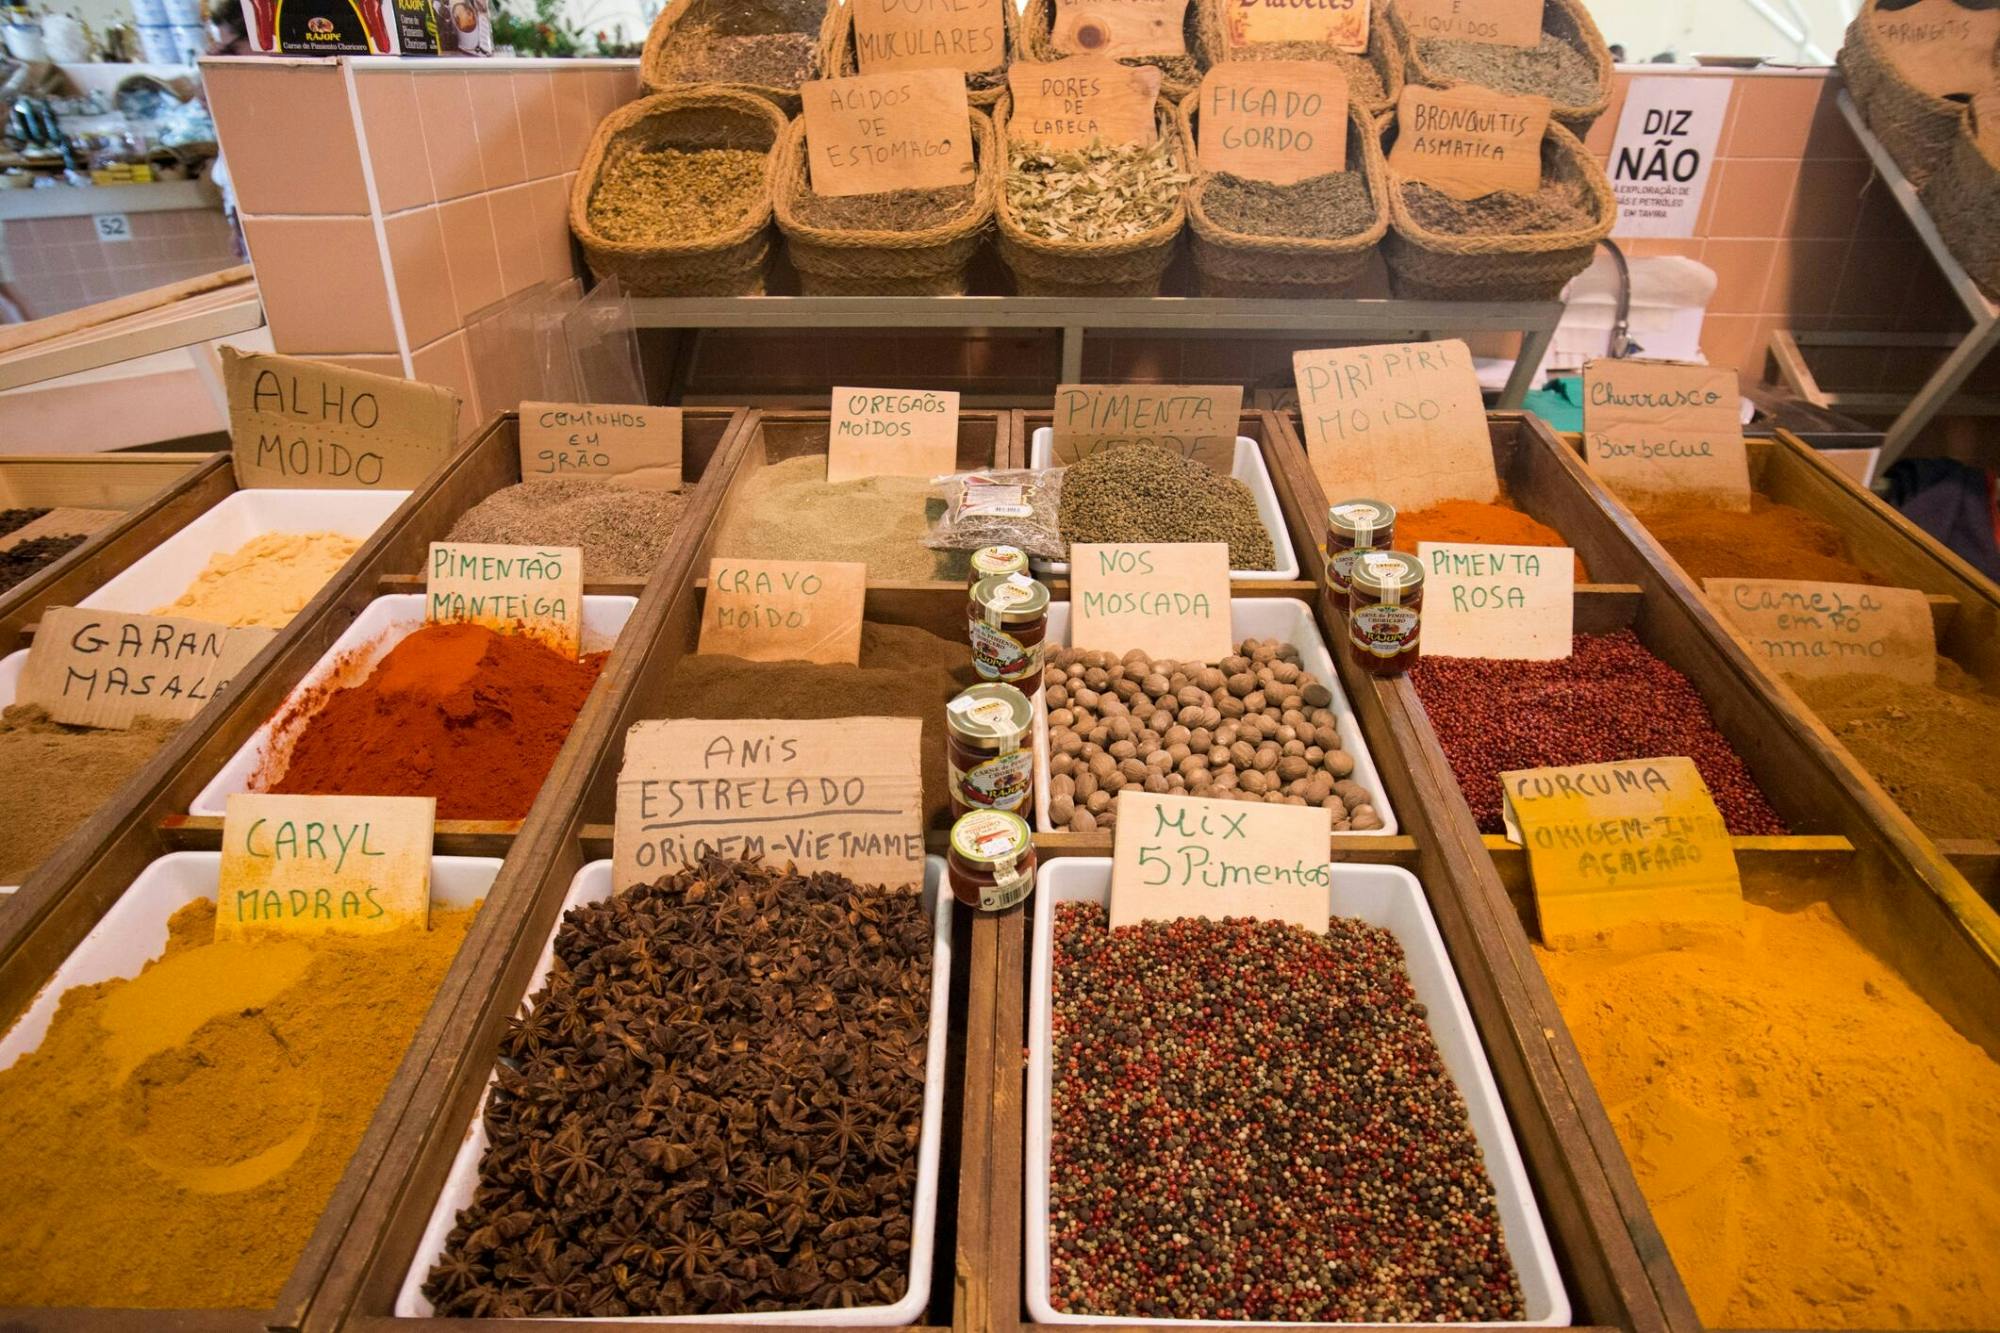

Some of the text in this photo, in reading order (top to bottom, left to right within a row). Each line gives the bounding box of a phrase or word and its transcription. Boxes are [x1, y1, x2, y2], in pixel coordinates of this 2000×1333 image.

[1043, 78, 1100, 97] DORES
[1065, 99, 1083, 114] DE
[1212, 86, 1322, 118] FIGADO
[859, 117, 887, 137] DE
[1643, 108, 1693, 136] DIZ
[1223, 126, 1313, 152] GORDO
[827, 139, 951, 168] ESTOMAGO
[1615, 139, 1700, 182] NÃO
[254, 370, 379, 429] ALHO
[1590, 382, 1722, 408] Churrasco
[1099, 549, 1154, 576] NOS
[716, 568, 823, 596] CRAVO
[1084, 592, 1210, 619] MOSCADA
[1452, 585, 1526, 612] ROSA
[1517, 767, 1671, 800] CURCUMA
[641, 777, 865, 820] ESTRELADO
[1155, 804, 1247, 839] Mix
[246, 818, 385, 874] CARYL
[1139, 846, 1171, 886] 5
[237, 885, 384, 922] MADRAS
